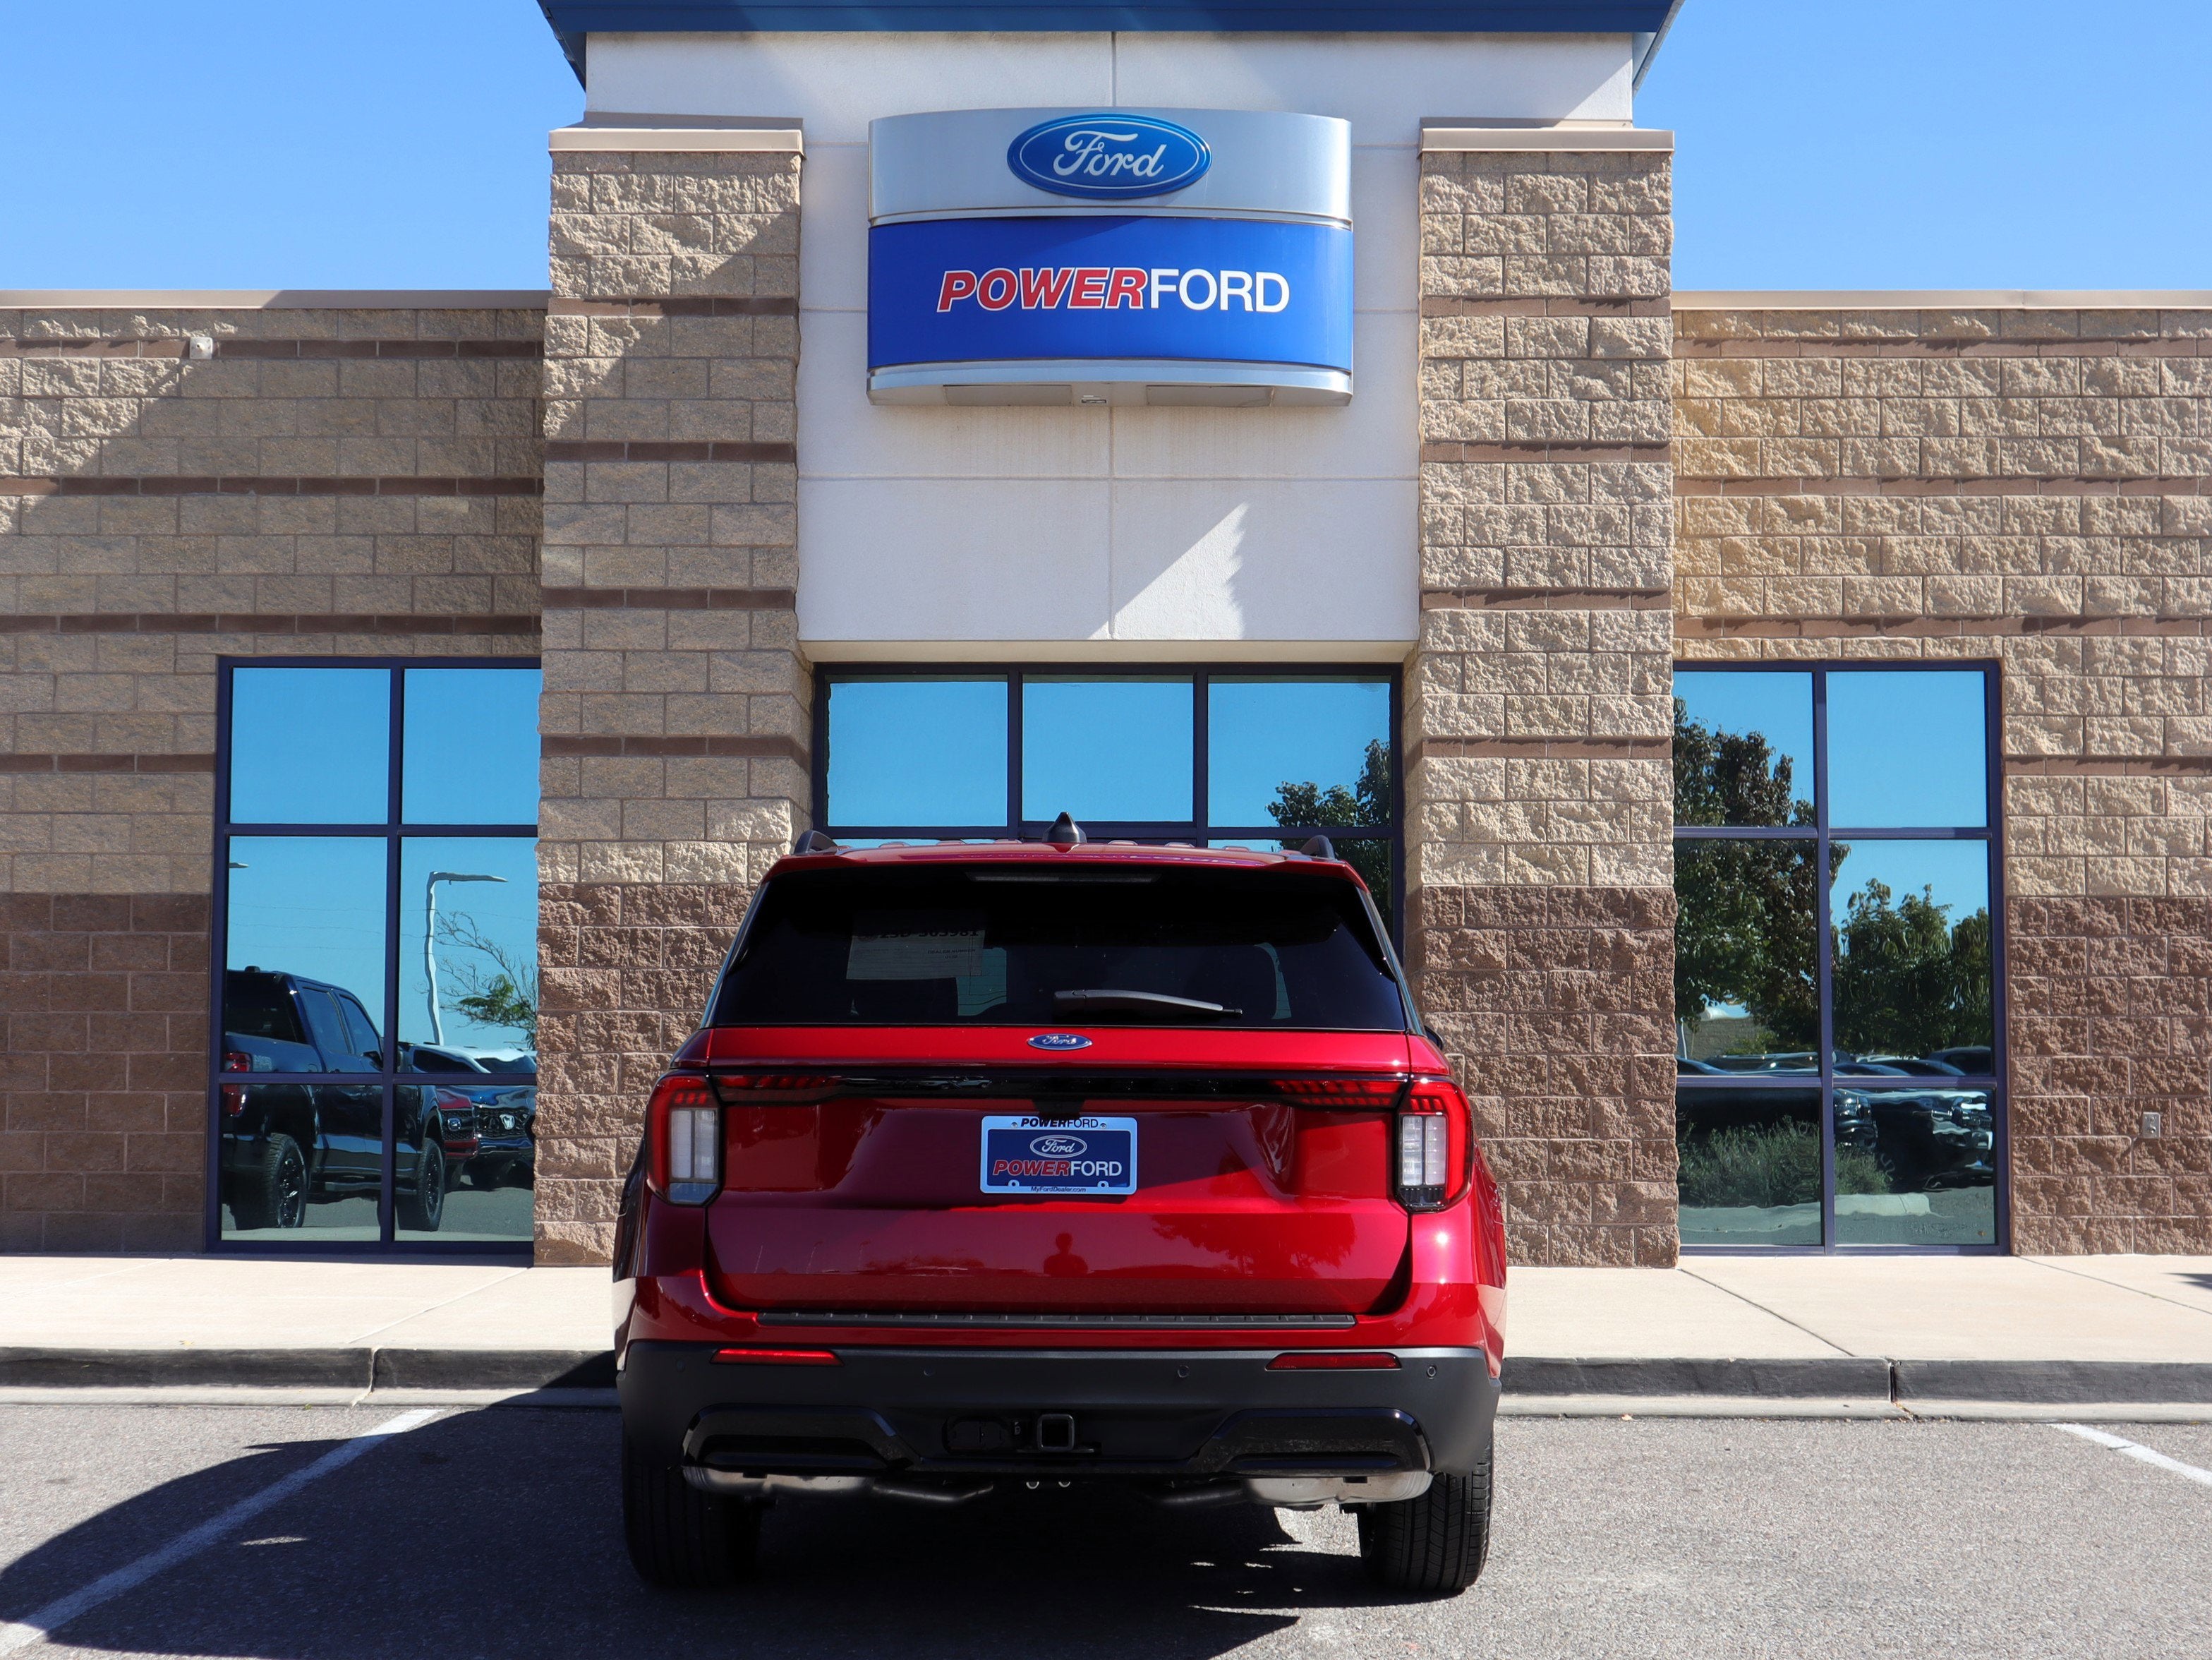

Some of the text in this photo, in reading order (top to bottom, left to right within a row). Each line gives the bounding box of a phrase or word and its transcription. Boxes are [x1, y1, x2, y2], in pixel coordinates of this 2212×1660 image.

[1053, 130, 1168, 178] Ford
[937, 267, 1290, 312] POWERFORD
[1021, 1118, 1099, 1128] POWERFORD
[1041, 1138, 1075, 1153] Ford
[993, 1160, 1123, 1177] POWERFORD
